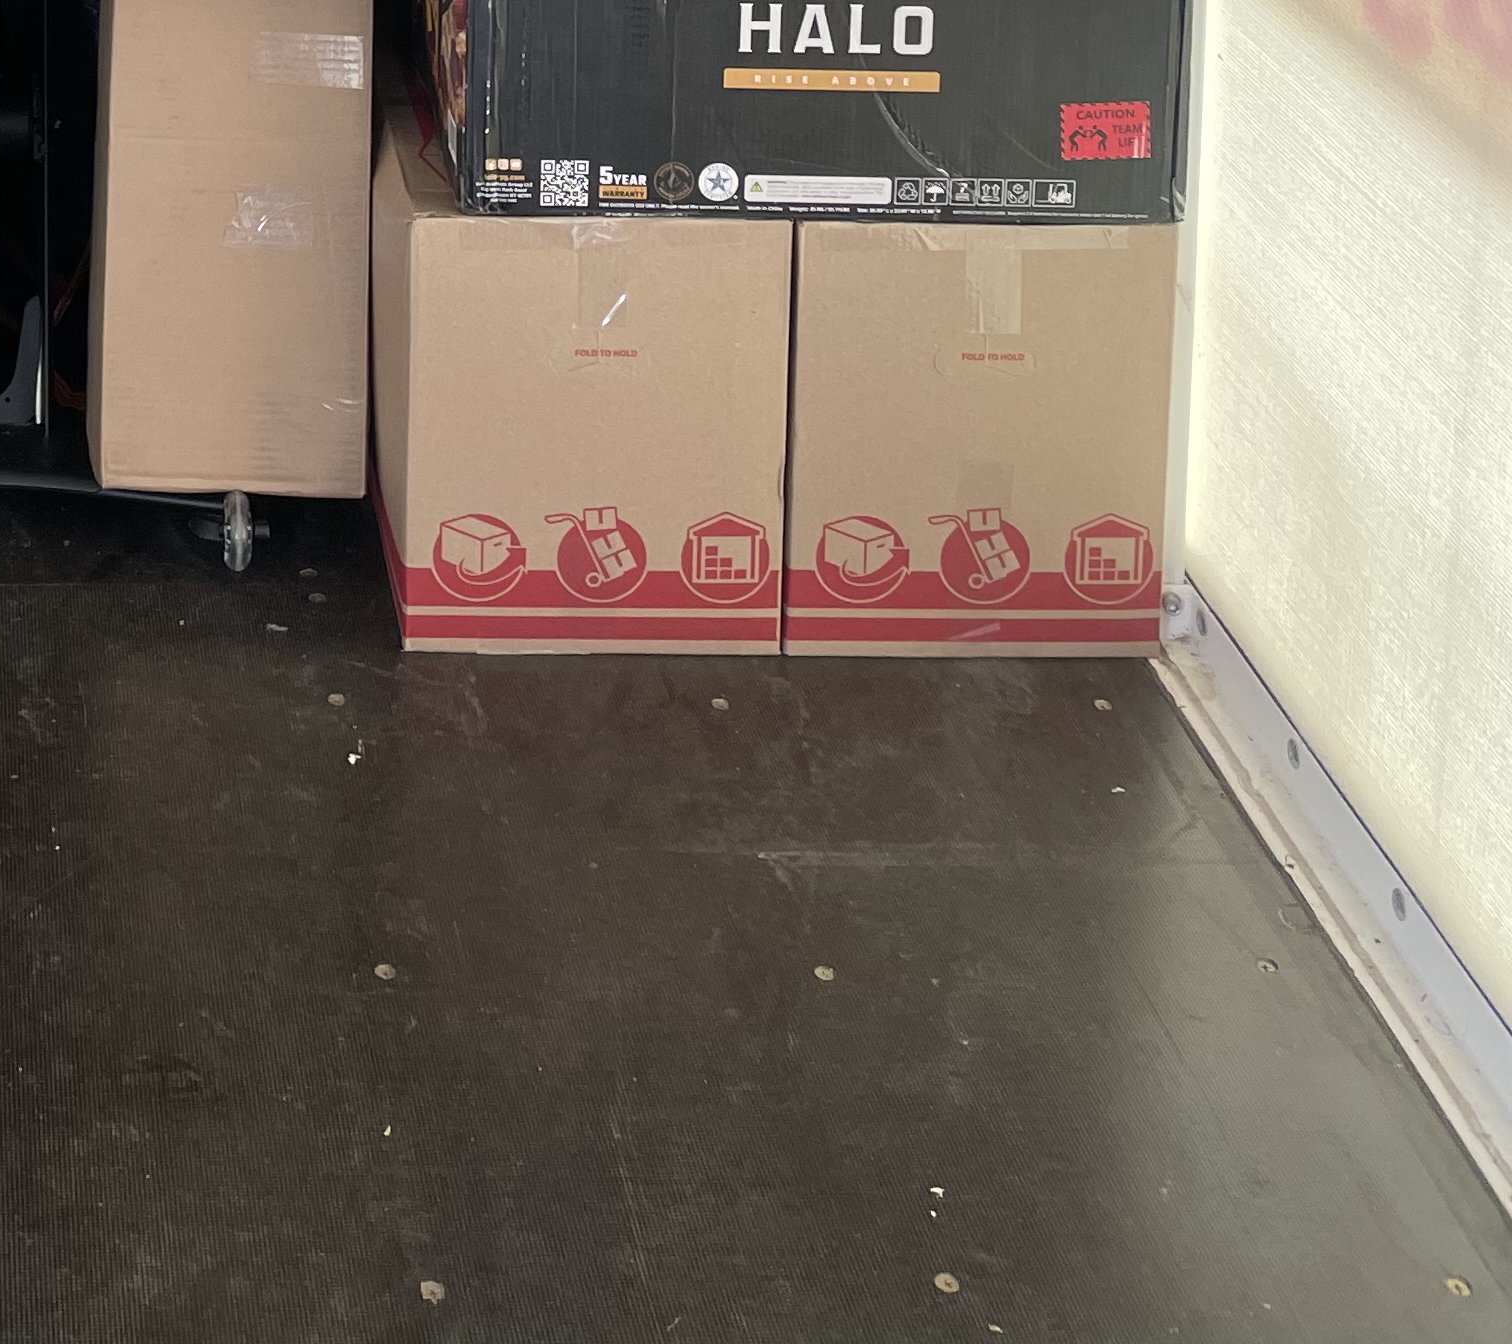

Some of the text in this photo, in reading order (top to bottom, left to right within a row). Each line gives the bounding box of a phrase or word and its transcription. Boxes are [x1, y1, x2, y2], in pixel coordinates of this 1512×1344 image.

[738, 3, 935, 55] HALO
[754, 75, 910, 87] RISE ABOVE
[1076, 109, 1135, 120] CAUTION
[1112, 123, 1143, 134] TEAM
[602, 190, 645, 198] WARRANTY
[574, 349, 638, 358] FOLD TO HOLD
[961, 352, 1026, 362] FOLD TO HOLD
